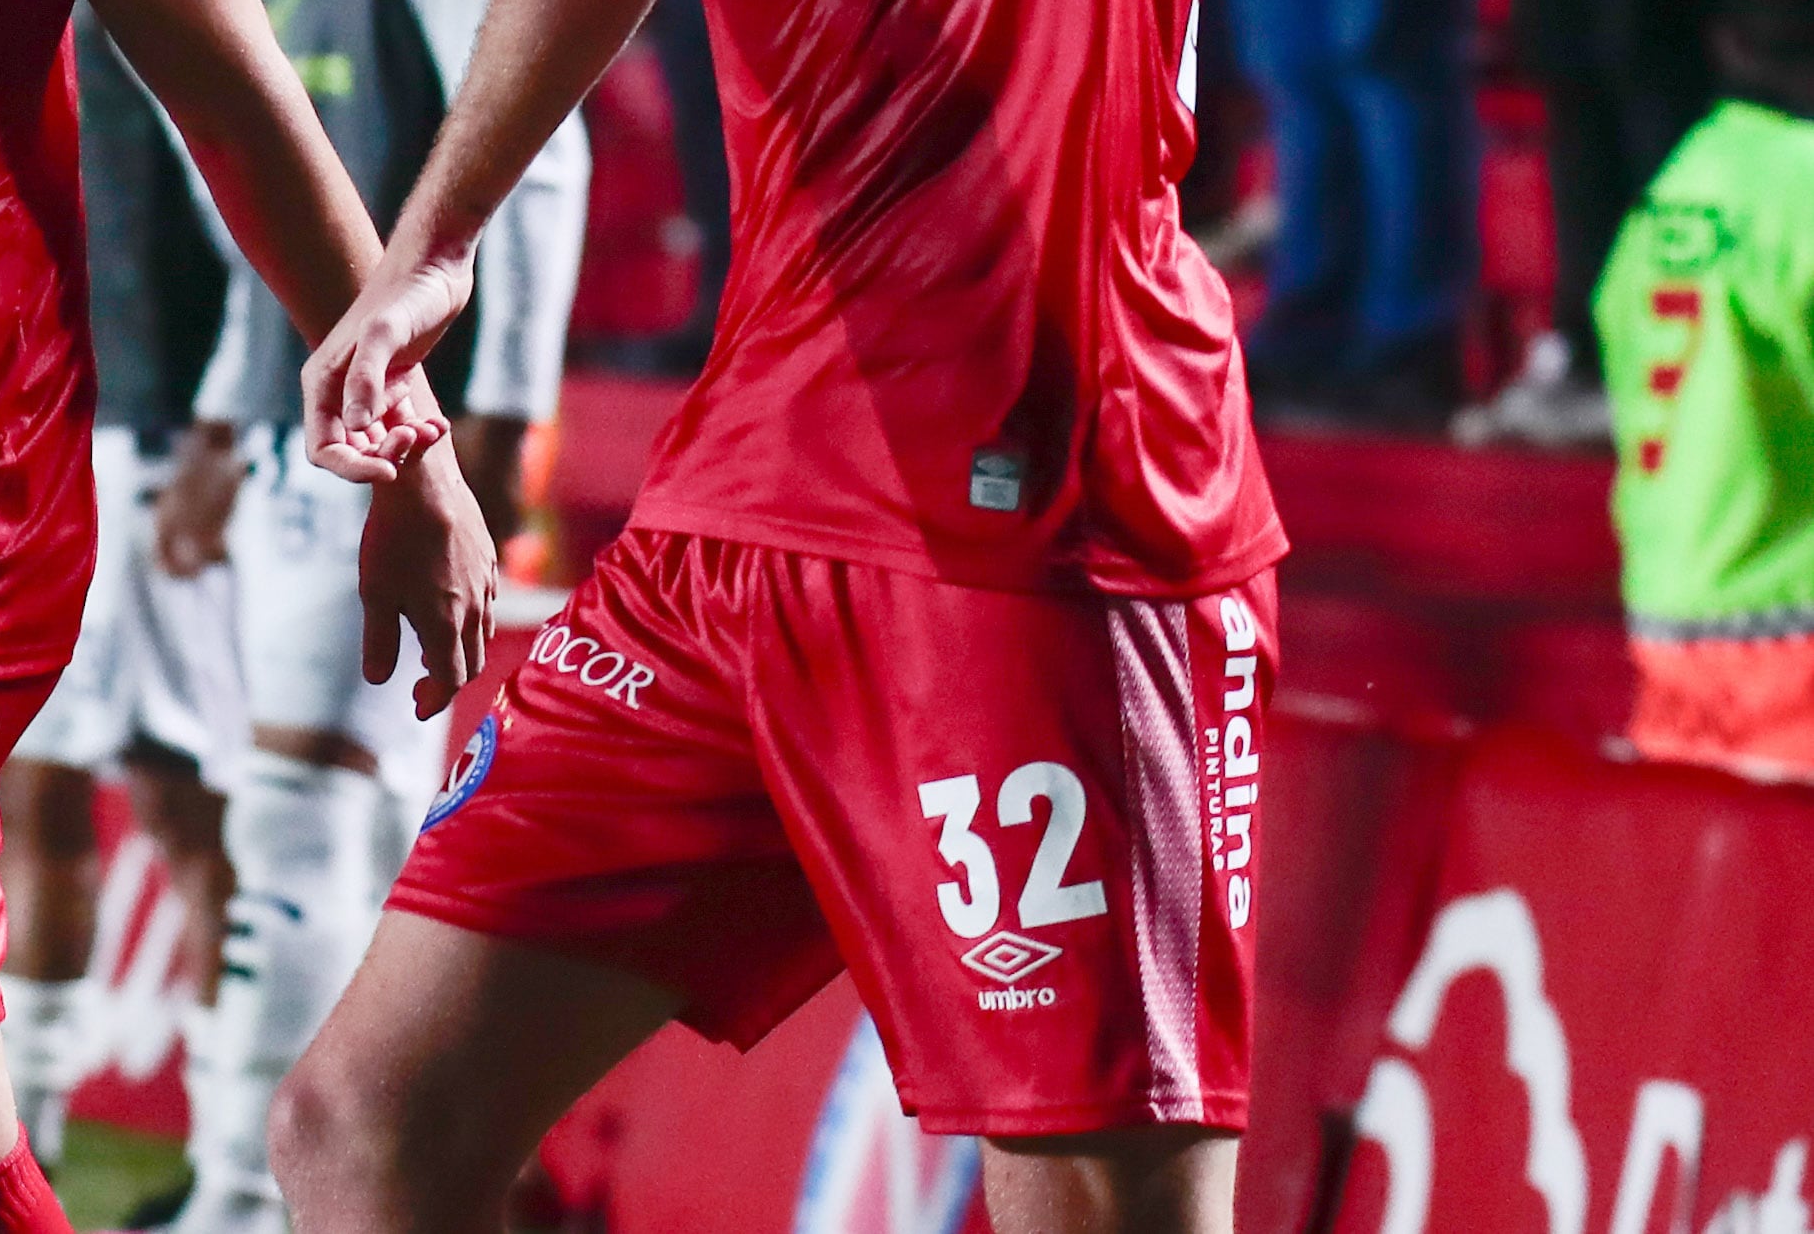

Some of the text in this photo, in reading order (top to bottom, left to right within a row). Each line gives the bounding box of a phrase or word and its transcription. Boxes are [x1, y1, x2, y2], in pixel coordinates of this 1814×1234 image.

[917, 760, 1109, 939] 32
[1218, 596, 1259, 931] andina
[977, 985, 1057, 1011] umbro
